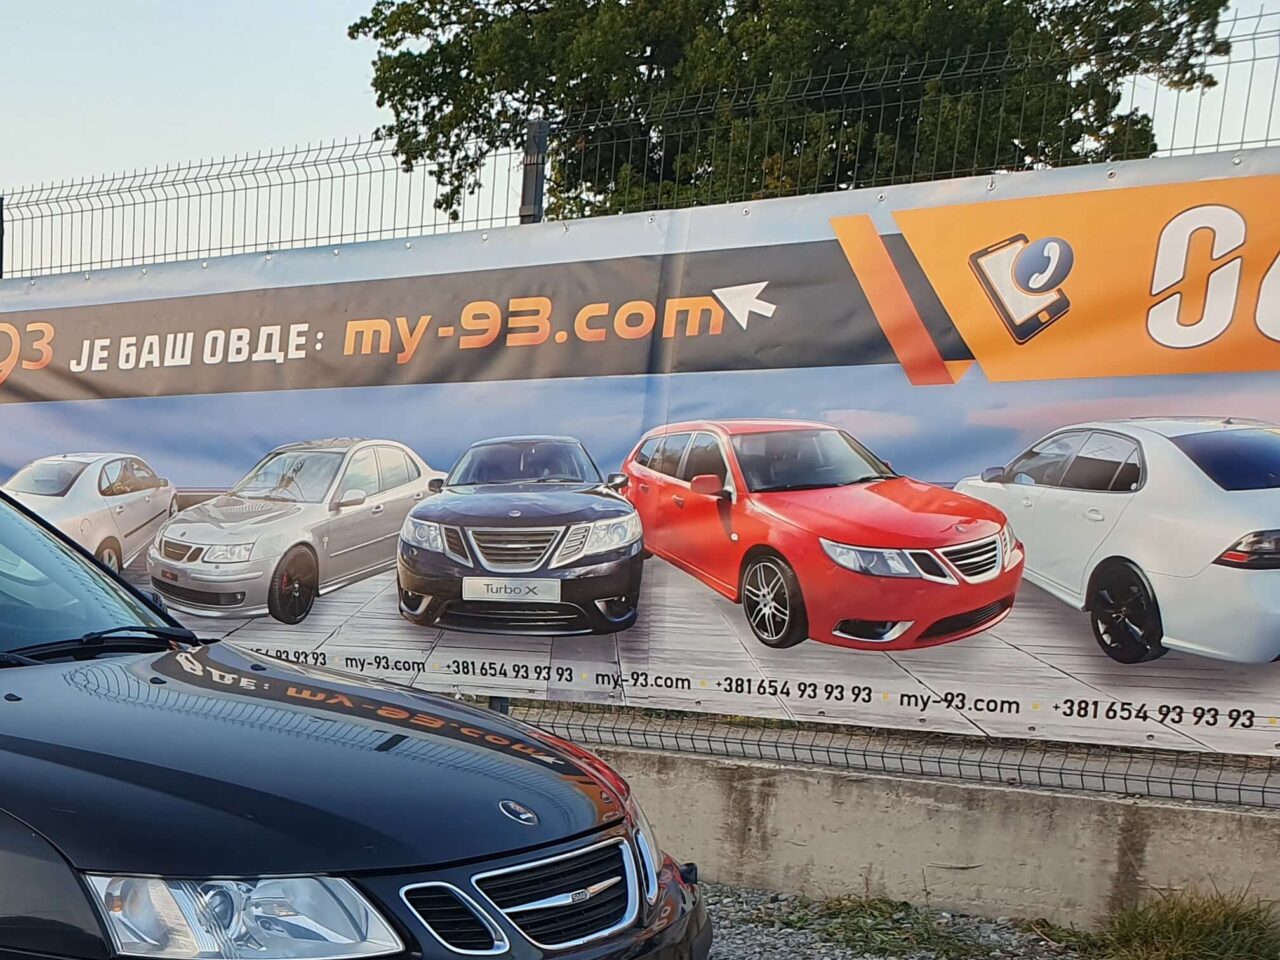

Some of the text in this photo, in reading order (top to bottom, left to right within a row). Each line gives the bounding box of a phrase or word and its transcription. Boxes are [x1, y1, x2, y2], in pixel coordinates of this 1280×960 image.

[1145, 202, 1280, 350] 0
[69, 337, 111, 373] ЈЕ
[117, 331, 195, 371] БАШ
[342, 295, 725, 365] my-93.com
[483, 583, 539, 596] Turbo X
[293, 650, 308, 664] 93
[311, 651, 327, 666] 93
[344, 654, 426, 673] my-93.com
[512, 662, 530, 680] 93
[534, 664, 552, 682] 93
[555, 666, 574, 683] 93
[595, 670, 692, 691] my-93.com
[796, 681, 818, 700] 93
[823, 683, 845, 702] 93
[850, 685, 873, 704] 93
[899, 690, 1021, 715] my-93.com
[1157, 704, 1184, 724] 93
[1191, 706, 1219, 726] 93
[1227, 708, 1255, 729] 93
